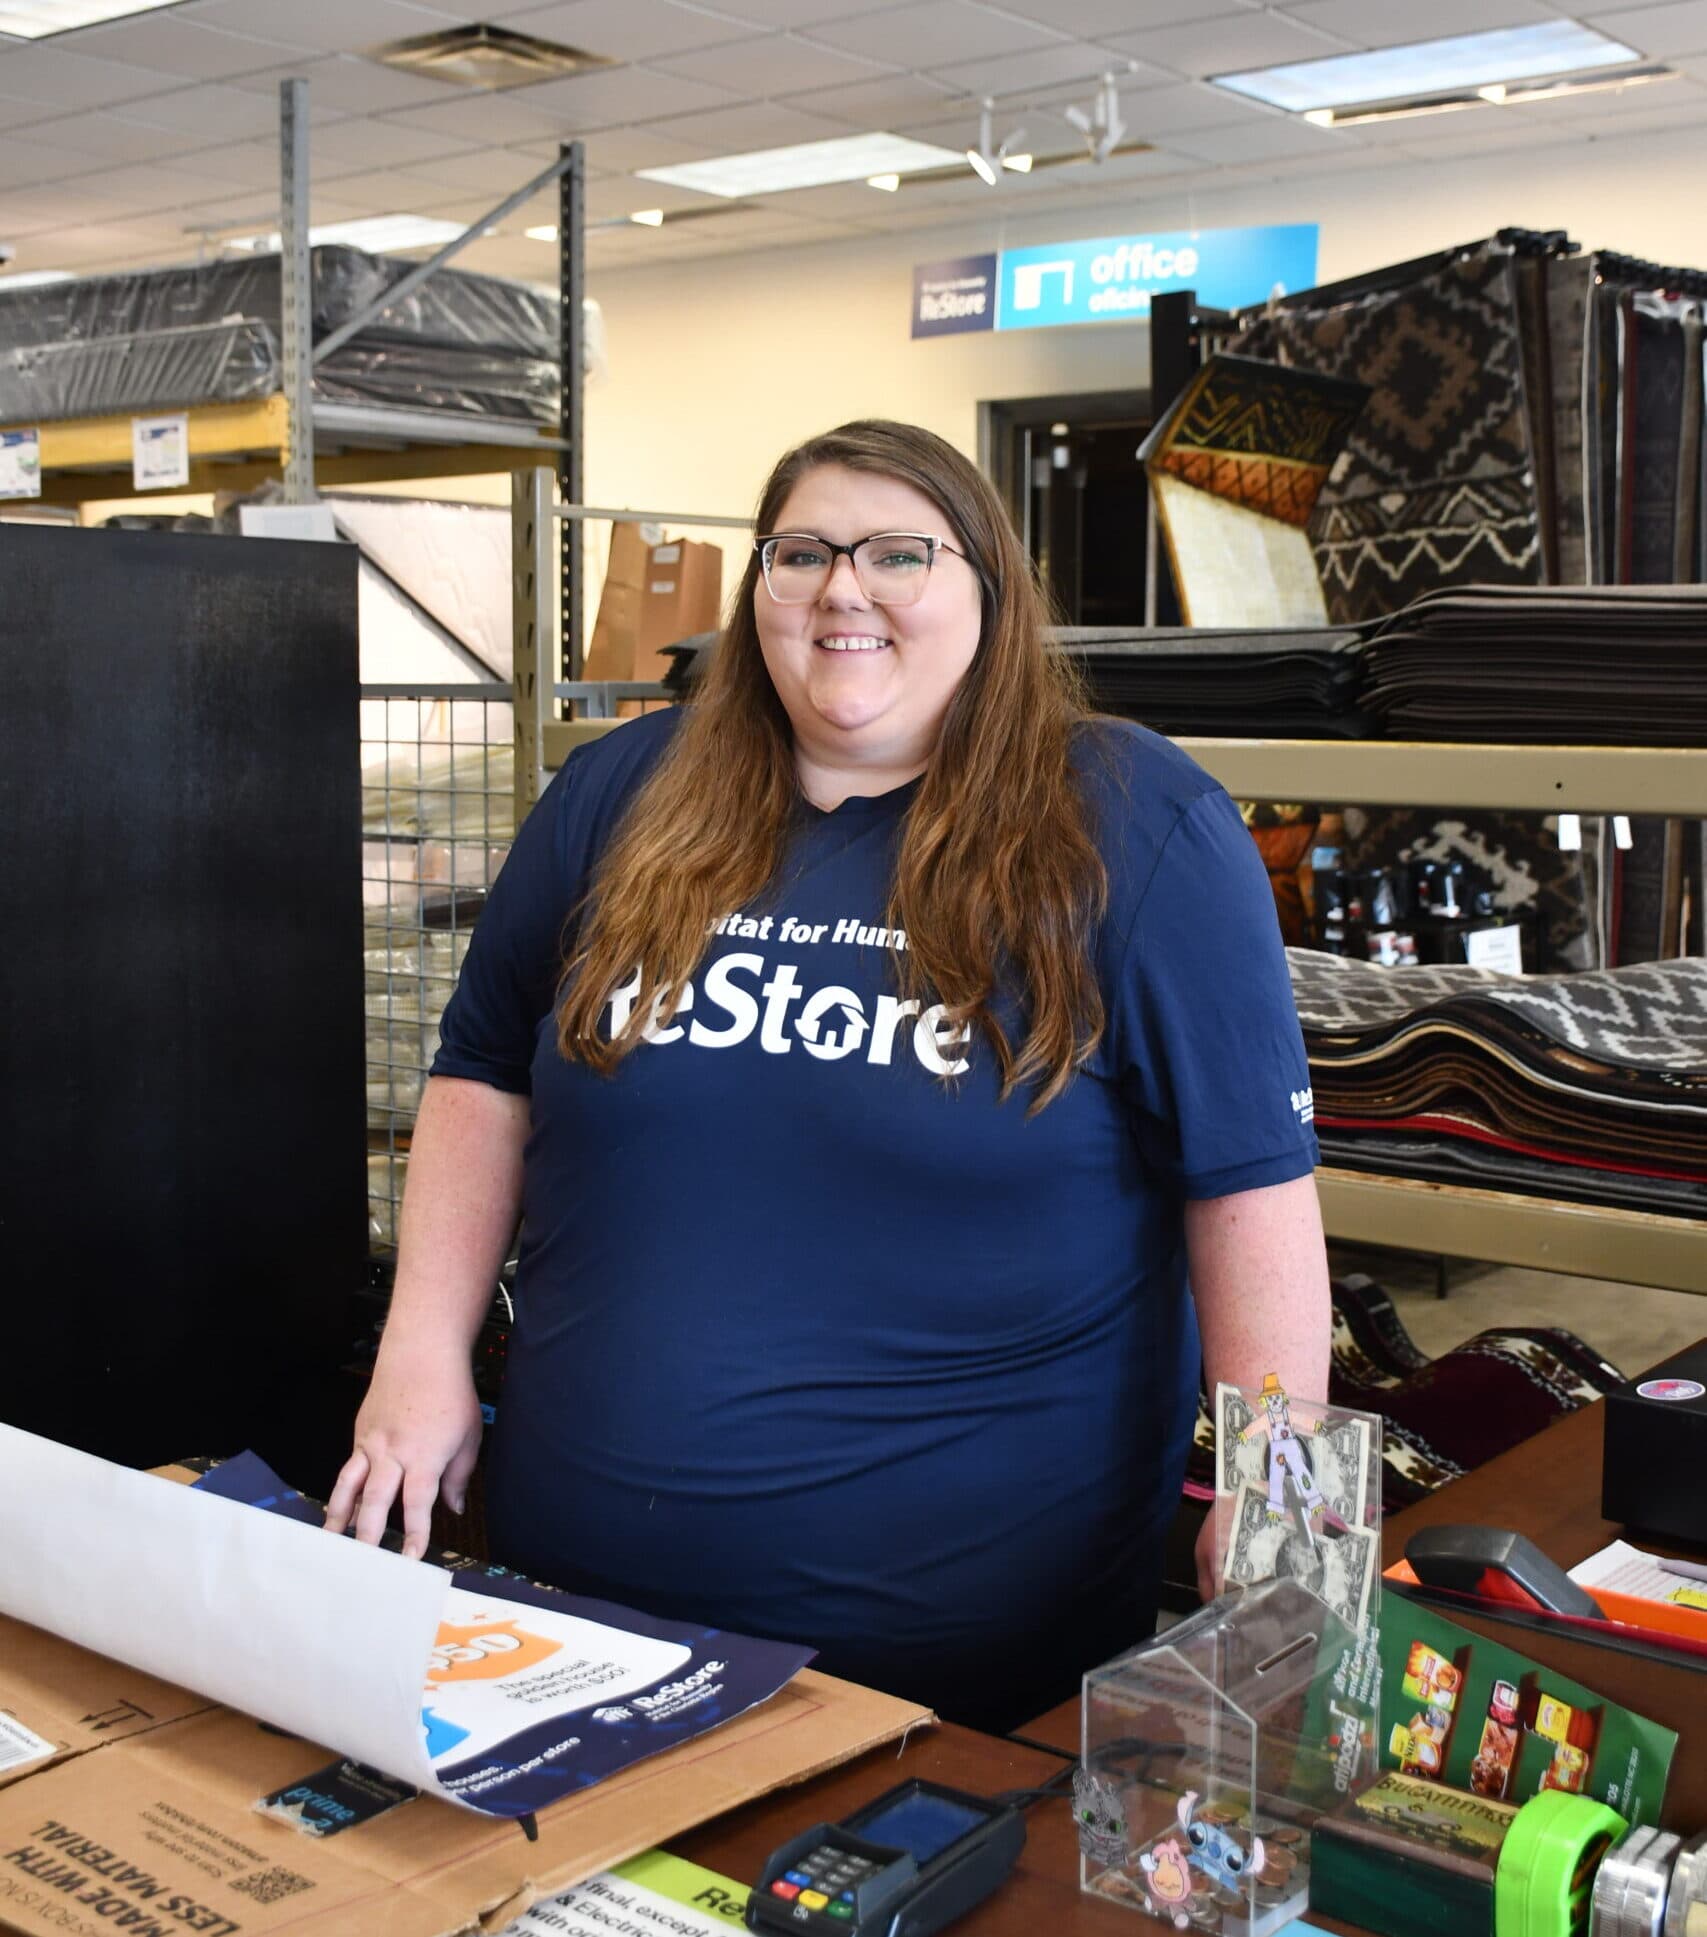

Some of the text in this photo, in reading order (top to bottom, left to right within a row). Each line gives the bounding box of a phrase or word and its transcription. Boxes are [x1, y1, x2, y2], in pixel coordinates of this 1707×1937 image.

[1090, 243, 1198, 285] office
[1088, 285, 1161, 313] oficin
[704, 912, 912, 952] itat for Hum
[632, 1660, 725, 1710] ReStore
[468, 1767, 520, 1794] person
[518, 1756, 544, 1773] per
[543, 1736, 581, 1761] store
[284, 1786, 356, 1822] prime
[3, 1845, 176, 1937] MADE WITH
[30, 1819, 242, 1937] LESS MATERIAL
[526, 1904, 569, 1930] with
[554, 1893, 578, 1907] &
[586, 1881, 710, 1937] final, except
[691, 1885, 747, 1922] Re
